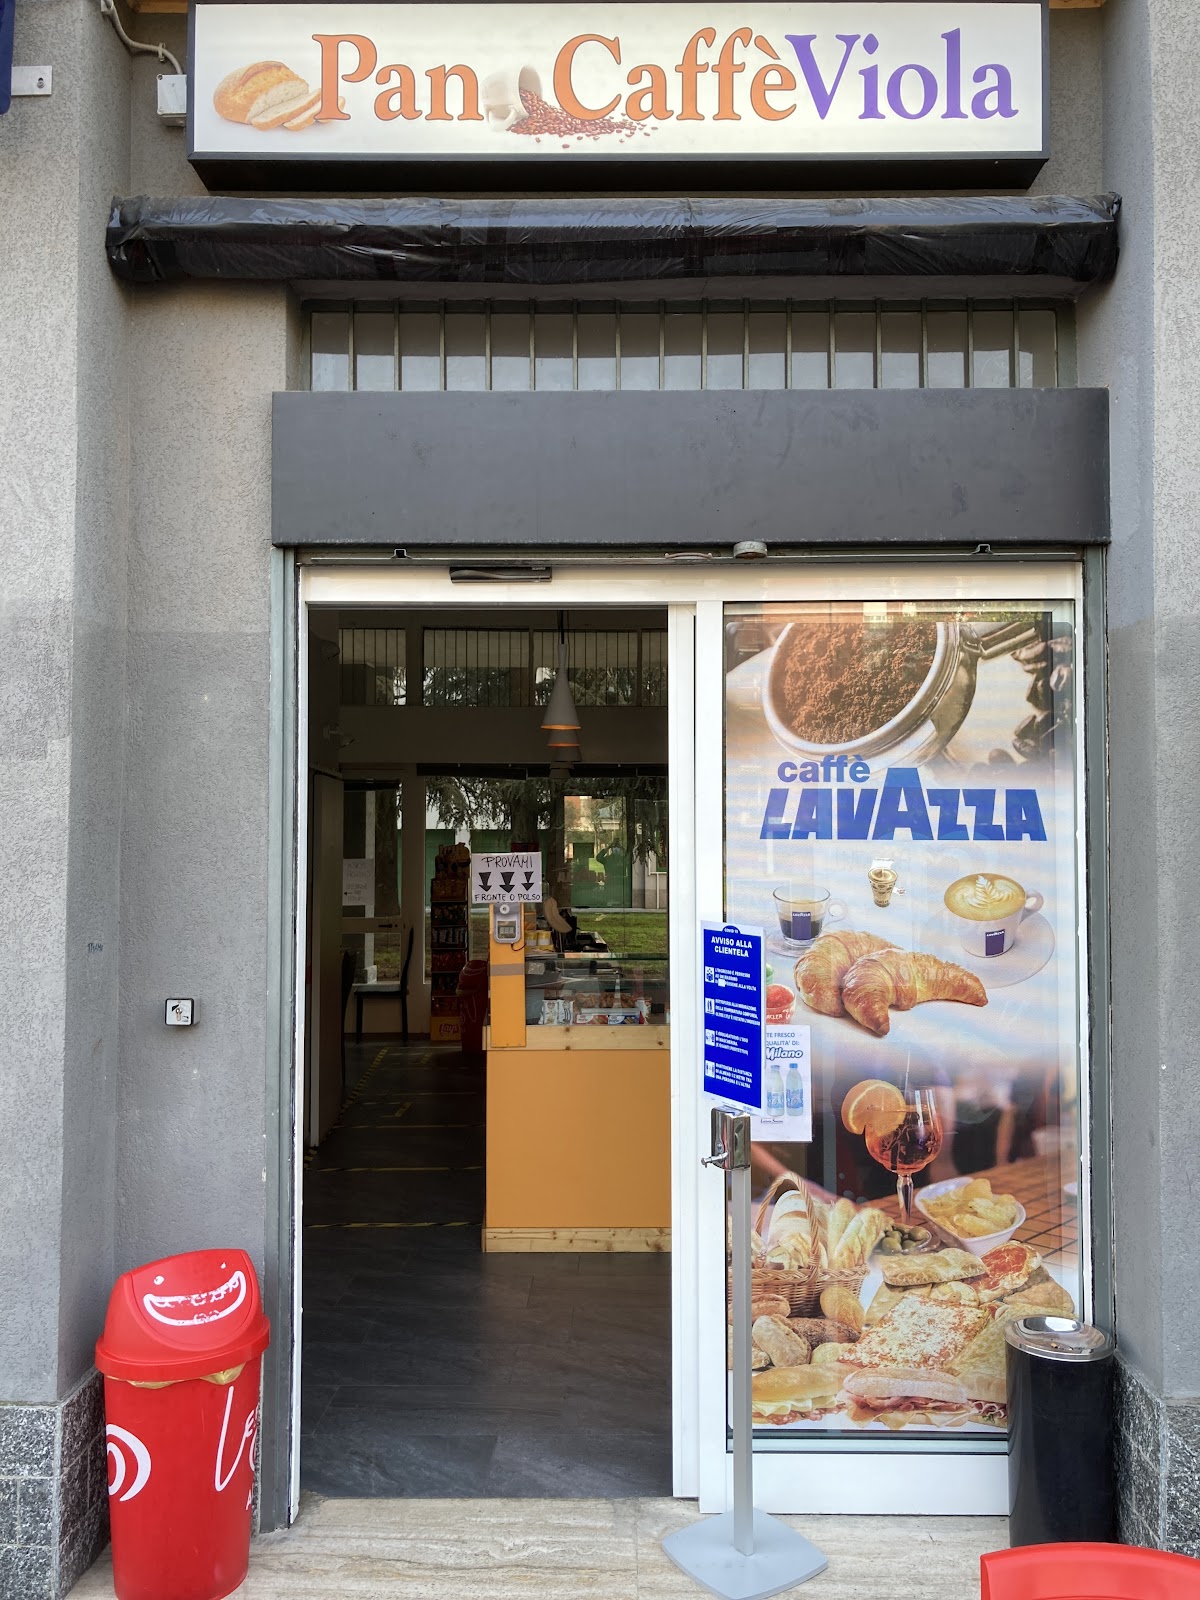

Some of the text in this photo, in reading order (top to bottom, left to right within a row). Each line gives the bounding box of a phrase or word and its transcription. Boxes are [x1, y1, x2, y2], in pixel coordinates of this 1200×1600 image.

[312, 34, 484, 121] Pan
[777, 755, 871, 783] caffè
[760, 767, 1047, 841] LAVAZZA
[481, 855, 533, 868] PROVAMI
[474, 893, 541, 902] FRONTE O POLSO
[711, 936, 752, 949] AVVISO ALLA
[714, 945, 749, 958] CLIENTELA
[766, 1046, 804, 1061] Milano
